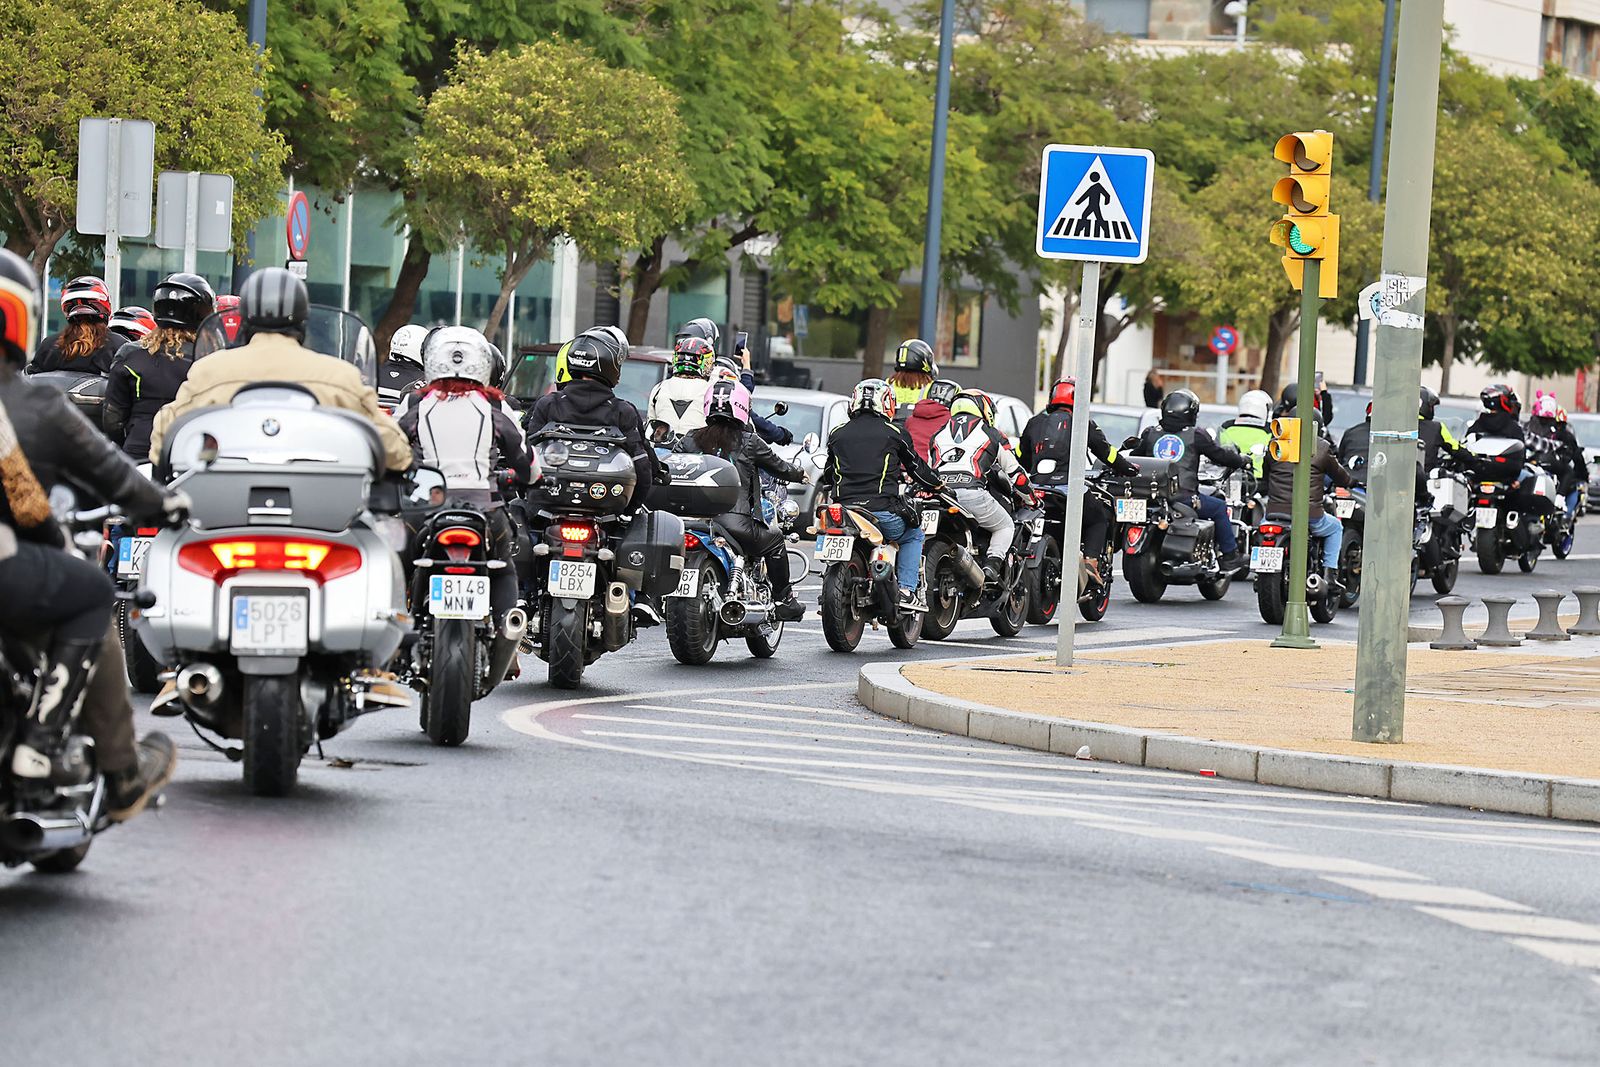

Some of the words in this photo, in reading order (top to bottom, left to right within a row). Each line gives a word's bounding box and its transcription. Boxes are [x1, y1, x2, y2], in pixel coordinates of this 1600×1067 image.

[825, 537, 850, 548] 7561
[823, 548, 843, 559] JPD
[1259, 549, 1281, 559] 9565
[560, 563, 593, 578] 8254
[682, 570, 696, 582] 67
[444, 579, 485, 595] 8148
[559, 577, 584, 591] LBX
[443, 596, 475, 611] MNW
[250, 623, 289, 644] LPT
